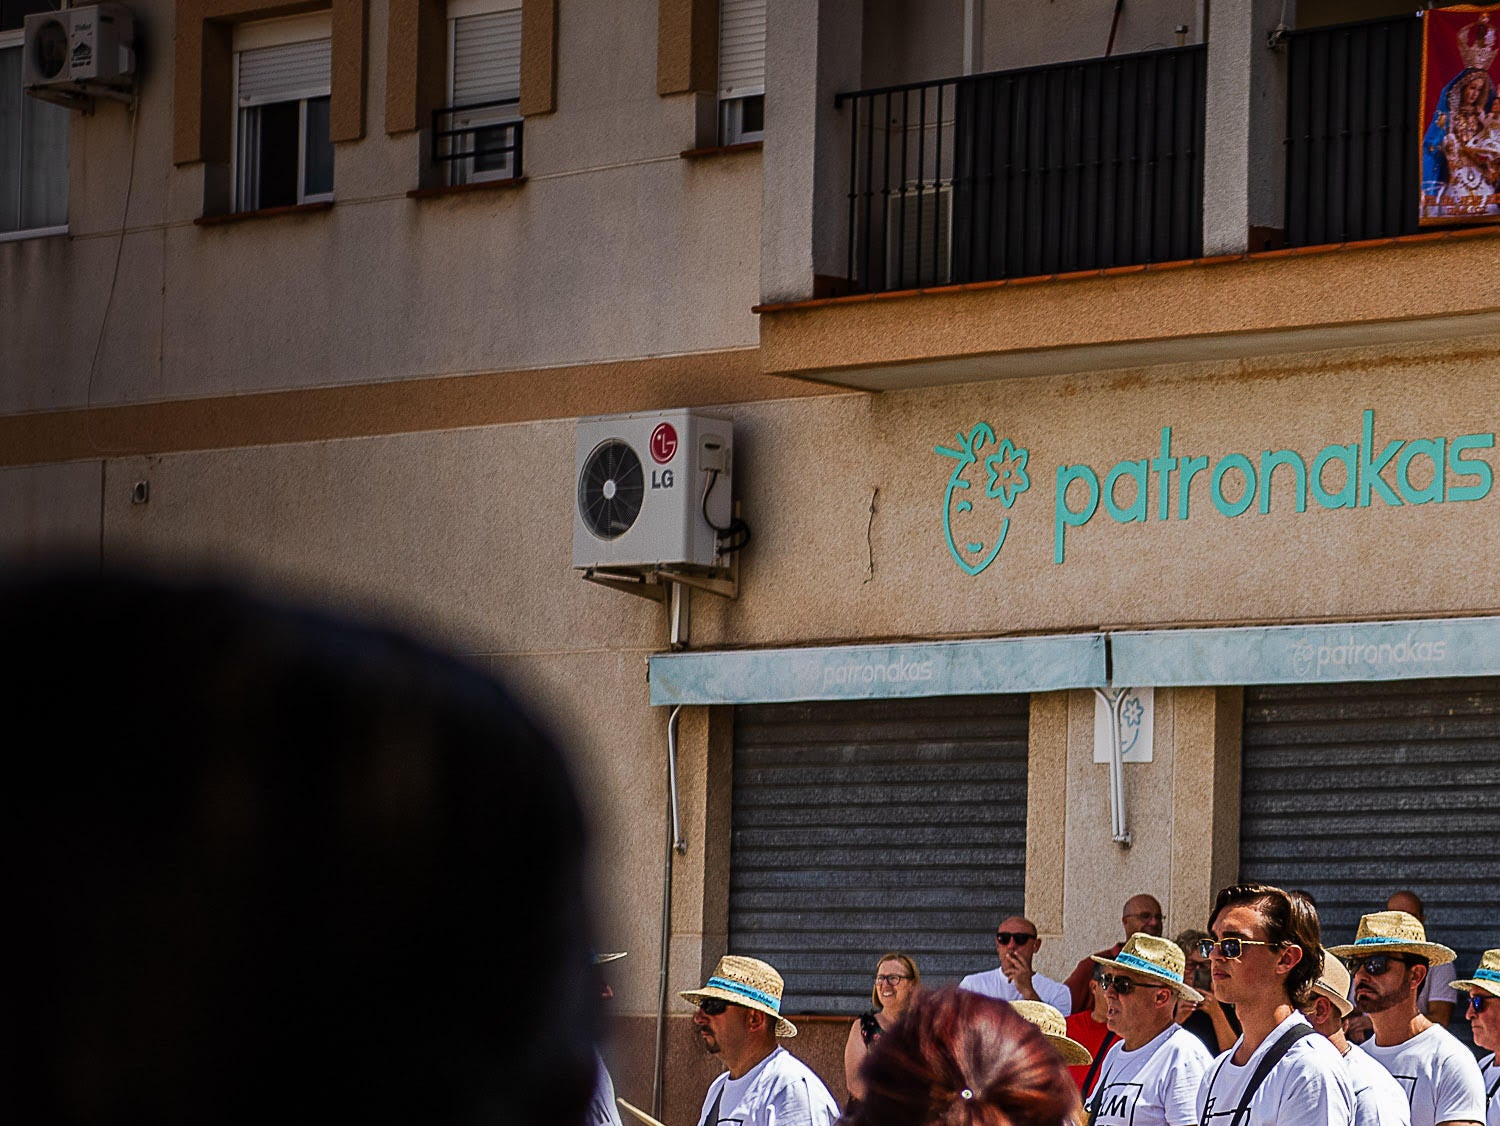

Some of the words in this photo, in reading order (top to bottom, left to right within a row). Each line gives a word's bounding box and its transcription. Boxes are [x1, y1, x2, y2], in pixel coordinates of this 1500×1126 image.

[651, 469, 674, 489] LG
[1054, 409, 1495, 565] patronakas
[823, 654, 933, 691] patronakas
[1316, 633, 1448, 677] patronakas
